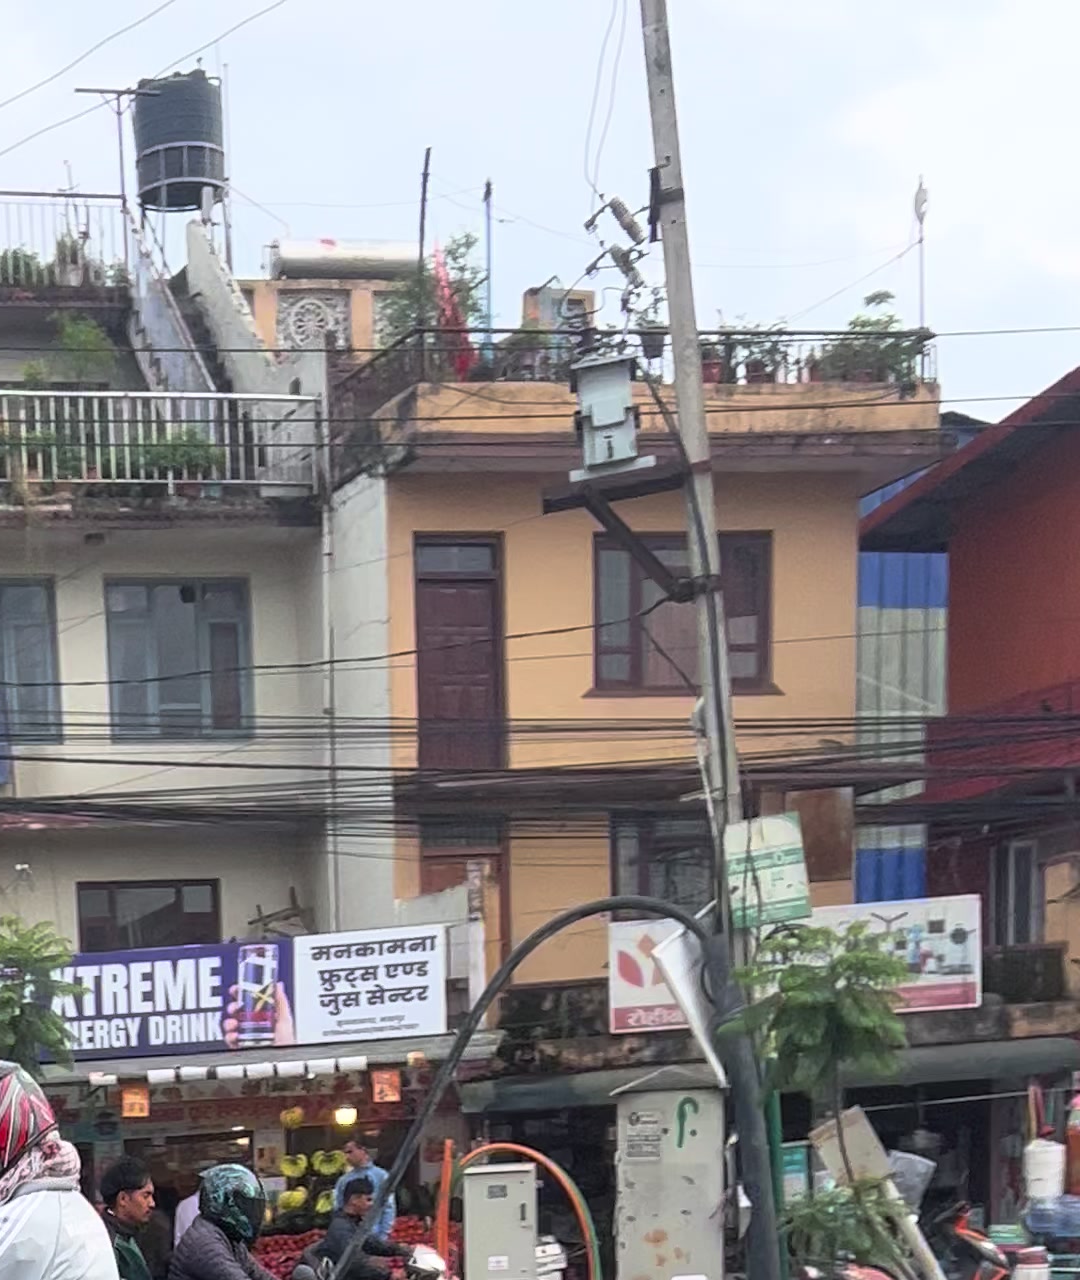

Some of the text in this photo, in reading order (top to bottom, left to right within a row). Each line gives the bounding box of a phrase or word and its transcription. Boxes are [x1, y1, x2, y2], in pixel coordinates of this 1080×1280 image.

[310, 935, 437, 961] मनकामना
[384, 960, 429, 979] एण्ड
[50, 957, 223, 1018] XTREME
[319, 984, 429, 1016] जुस सेन्टर
[64, 1016, 141, 1051] NERGY
[147, 1010, 224, 1047] DRINK
